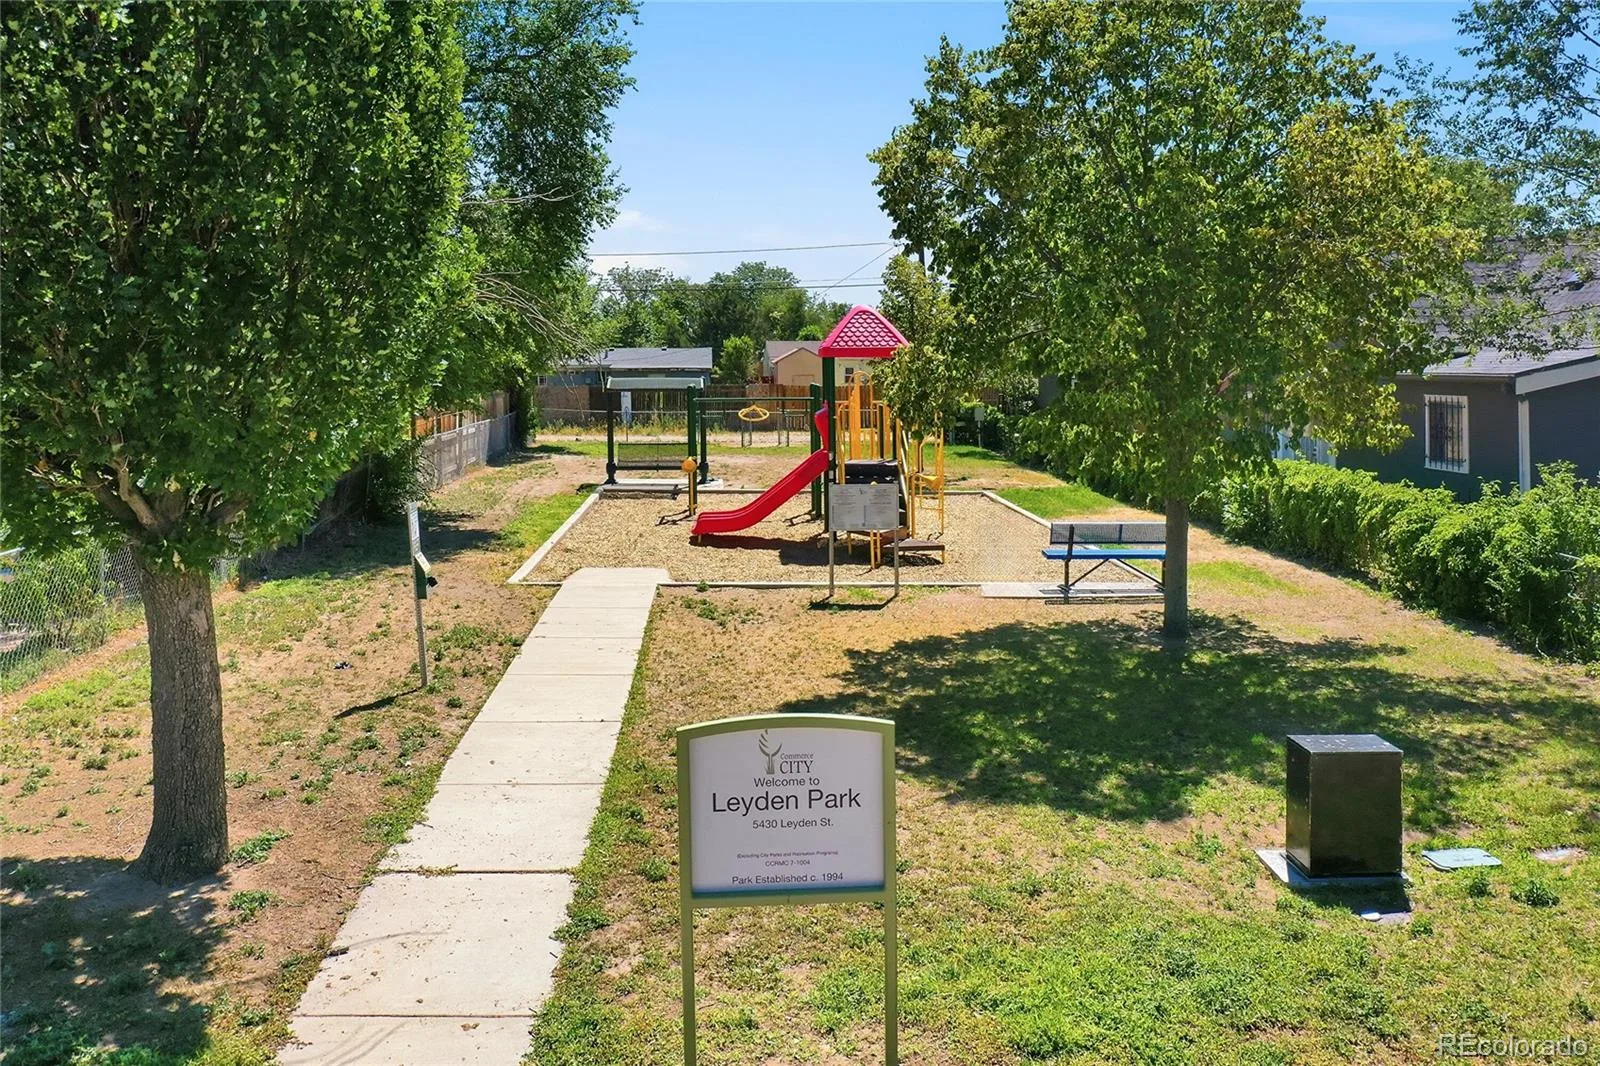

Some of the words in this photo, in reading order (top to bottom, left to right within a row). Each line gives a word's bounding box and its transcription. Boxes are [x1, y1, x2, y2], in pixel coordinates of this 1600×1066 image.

[779, 760, 814, 774] CITY
[753, 777, 805, 788] Welcome
[809, 776, 820, 786] to
[712, 791, 798, 816] Leyden
[808, 788, 862, 809] Park
[752, 819, 778, 829] 5430
[780, 818, 817, 830] Leyden
[819, 817, 834, 827] St.
[732, 875, 753, 885] Park
[755, 874, 808, 884] Established
[822, 872, 844, 882] 1994
